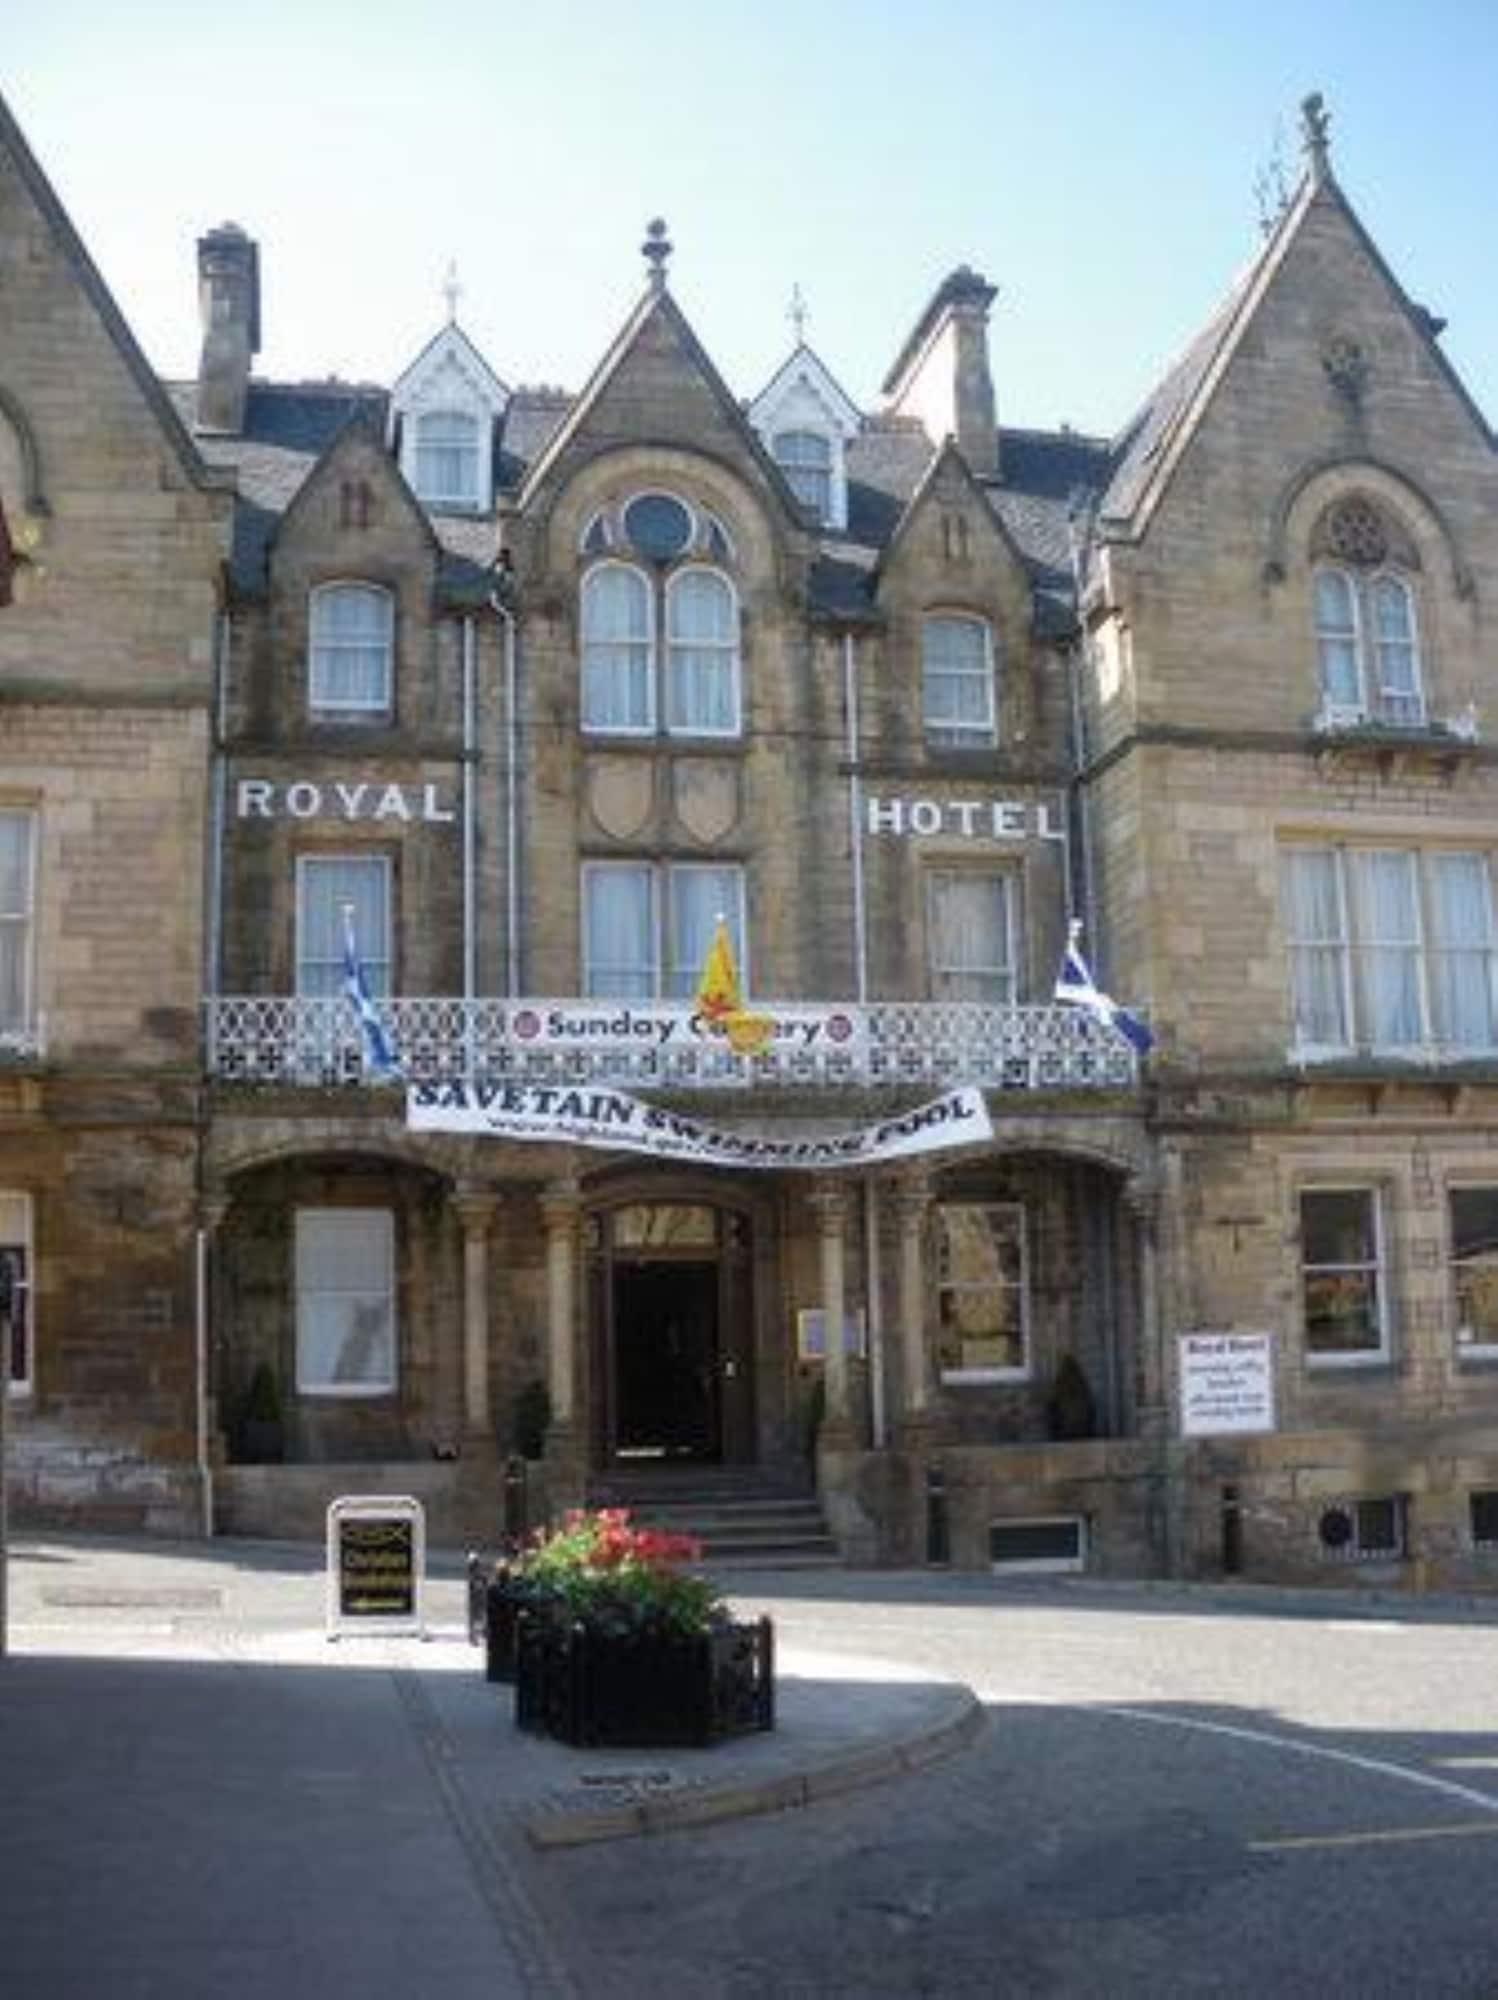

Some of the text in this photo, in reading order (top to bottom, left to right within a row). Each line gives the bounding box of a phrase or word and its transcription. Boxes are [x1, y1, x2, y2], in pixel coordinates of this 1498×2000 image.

[236, 780, 454, 822] ROYAL
[868, 797, 1066, 839] HOTEL
[547, 1010, 676, 1043] Sunday
[876, 1093, 976, 1145] POOL
